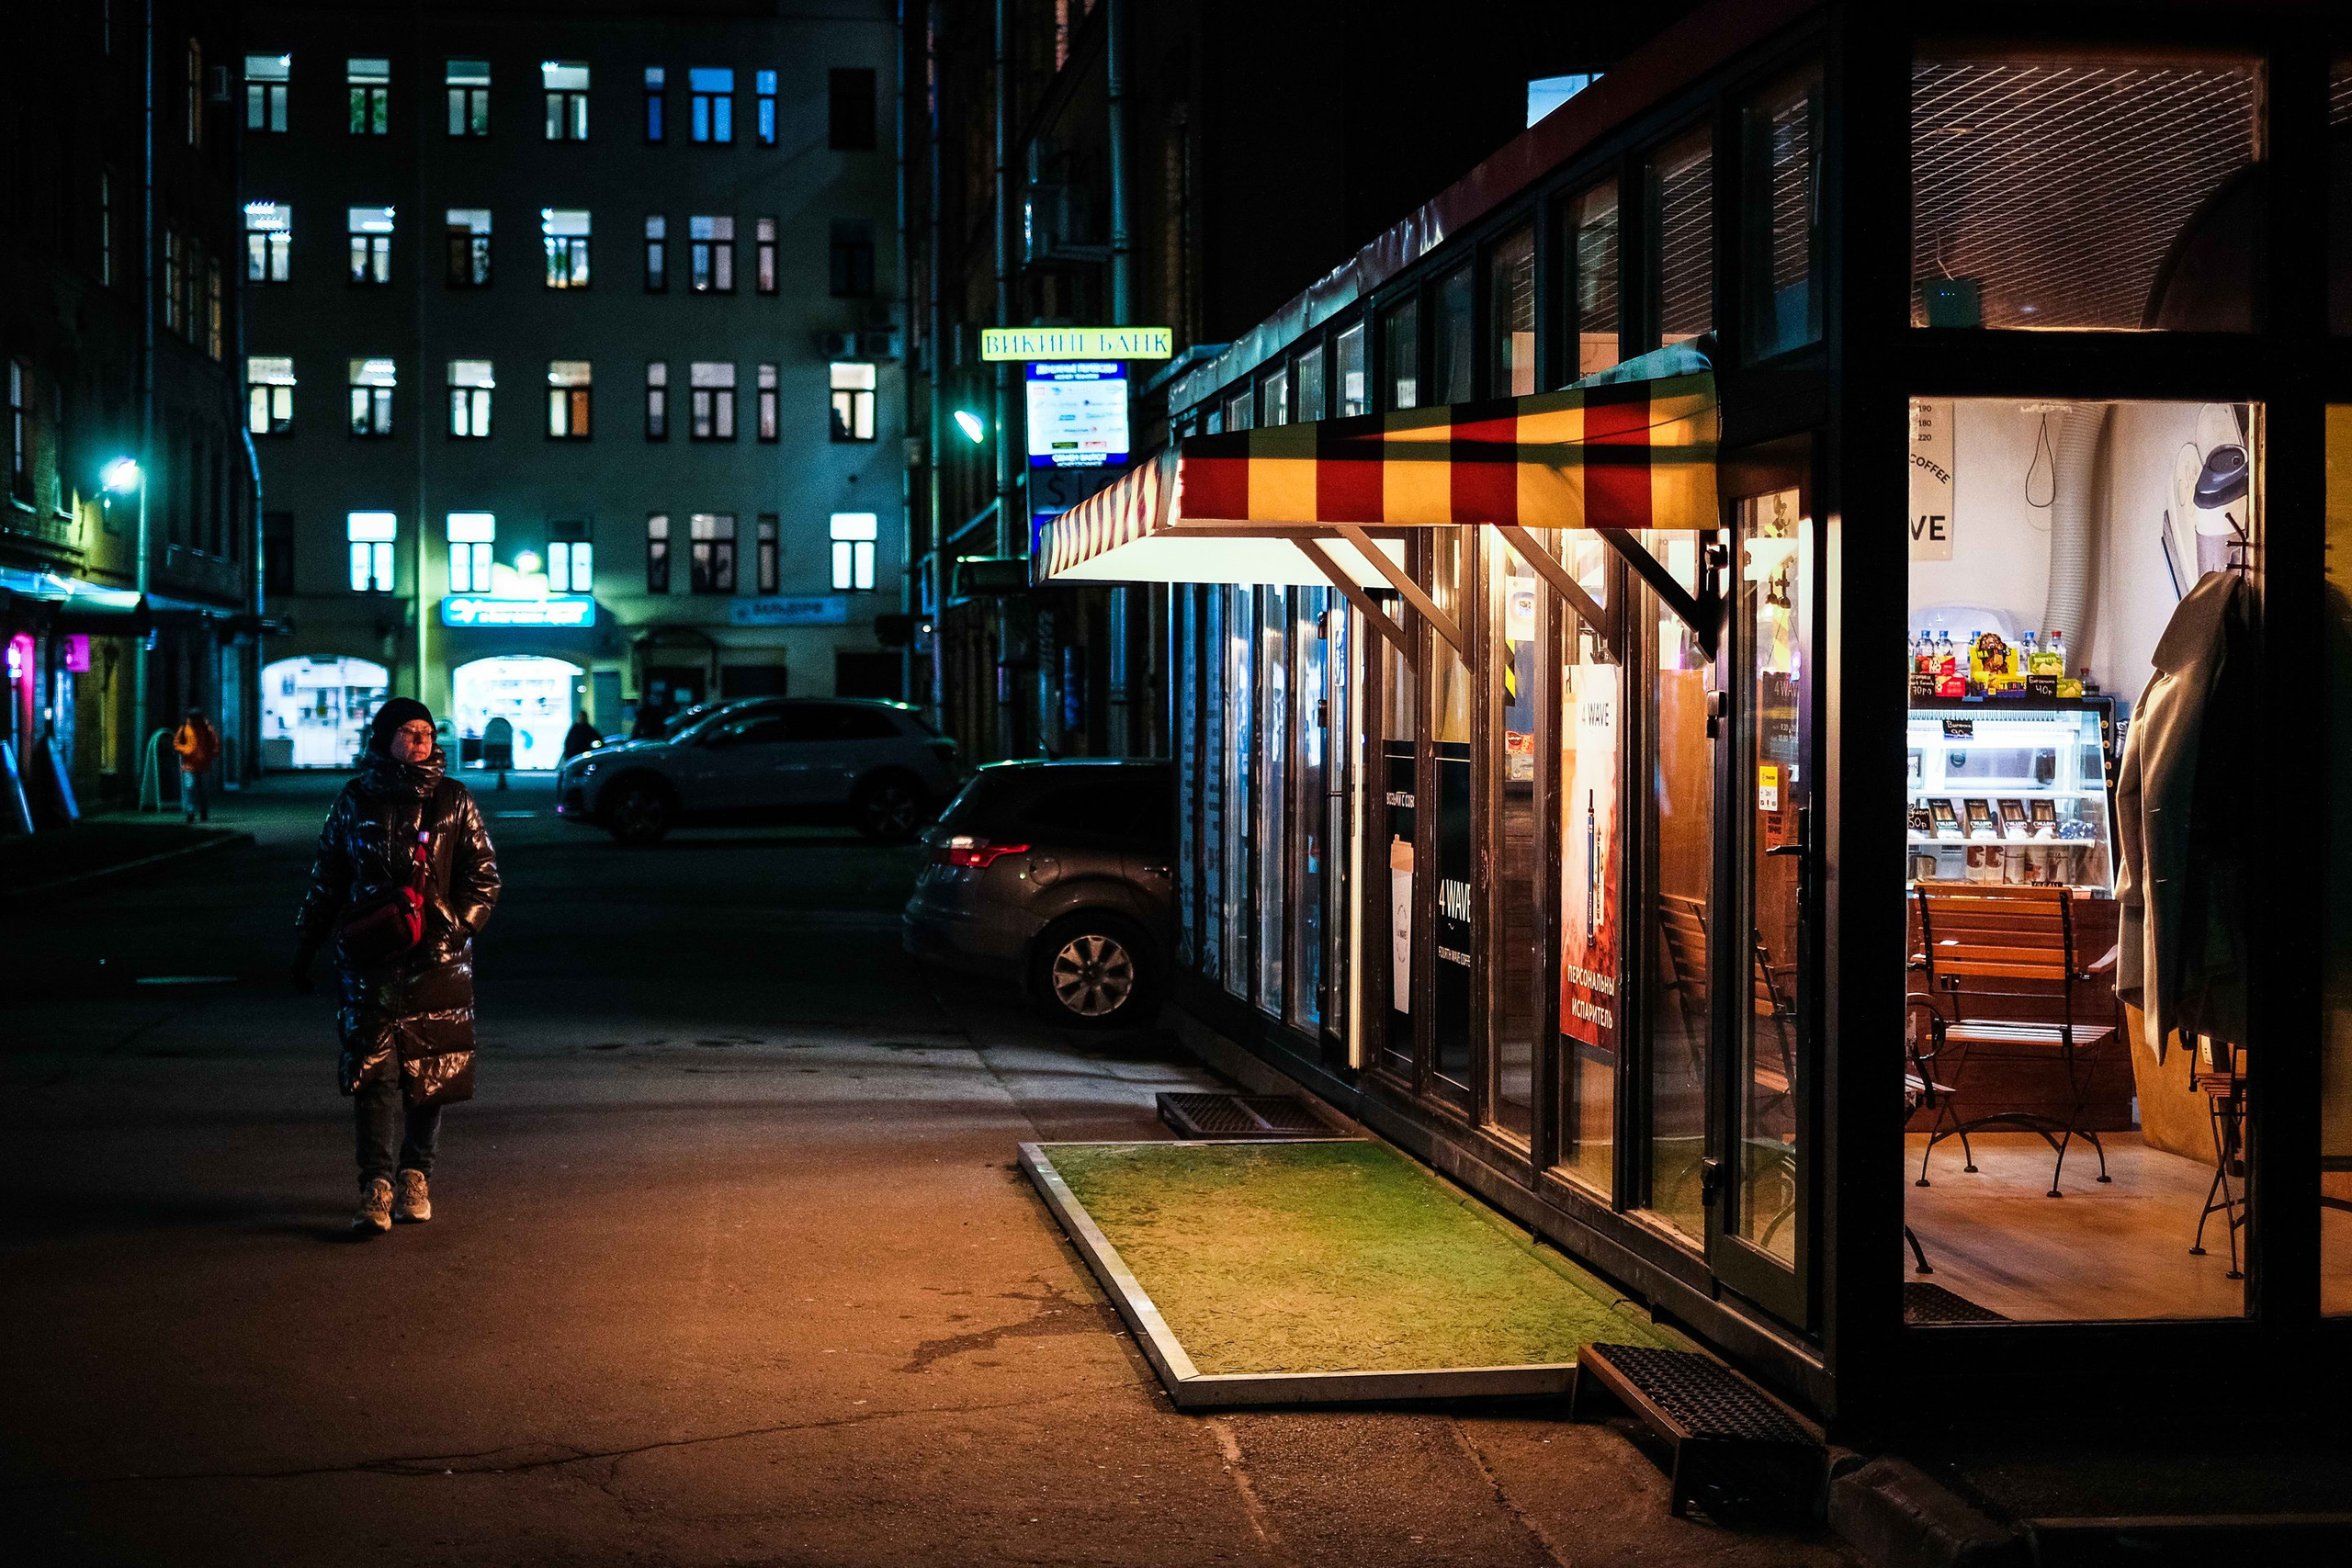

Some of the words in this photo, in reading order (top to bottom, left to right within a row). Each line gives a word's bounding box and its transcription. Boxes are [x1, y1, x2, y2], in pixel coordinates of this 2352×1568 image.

[1101, 333, 1168, 353] БАНК
[1909, 454, 1951, 485] COFFEE
[1774, 681, 1780, 696] 4
[1581, 703, 1587, 726] 4
[1588, 703, 1609, 727] WAVE
[1439, 879, 1445, 916] 4
[1446, 879, 1470, 923] WAVE
[1439, 946, 1452, 962] FOURTH
[1452, 950, 1460, 964] WAVE
[1572, 998, 1613, 1030] ИСПАРИТЕЛЬ
